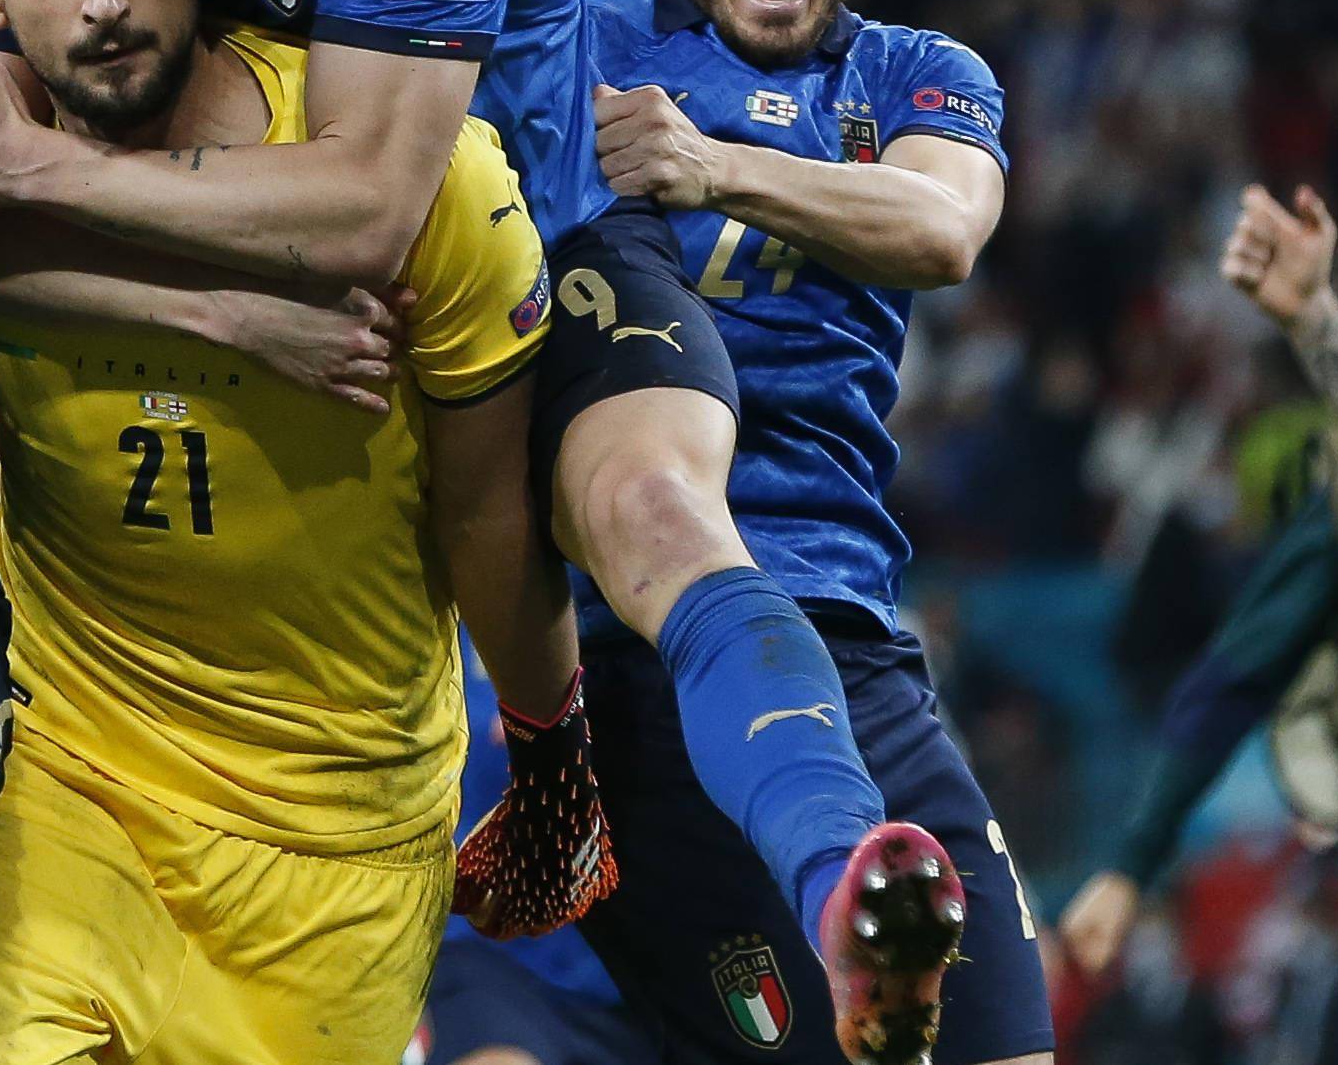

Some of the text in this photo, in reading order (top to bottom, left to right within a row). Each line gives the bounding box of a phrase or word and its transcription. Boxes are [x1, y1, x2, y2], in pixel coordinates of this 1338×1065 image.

[558, 268, 616, 331] 9
[77, 356, 241, 386] ITALIA
[118, 425, 214, 536] 21
[718, 955, 769, 986] ITALIA
